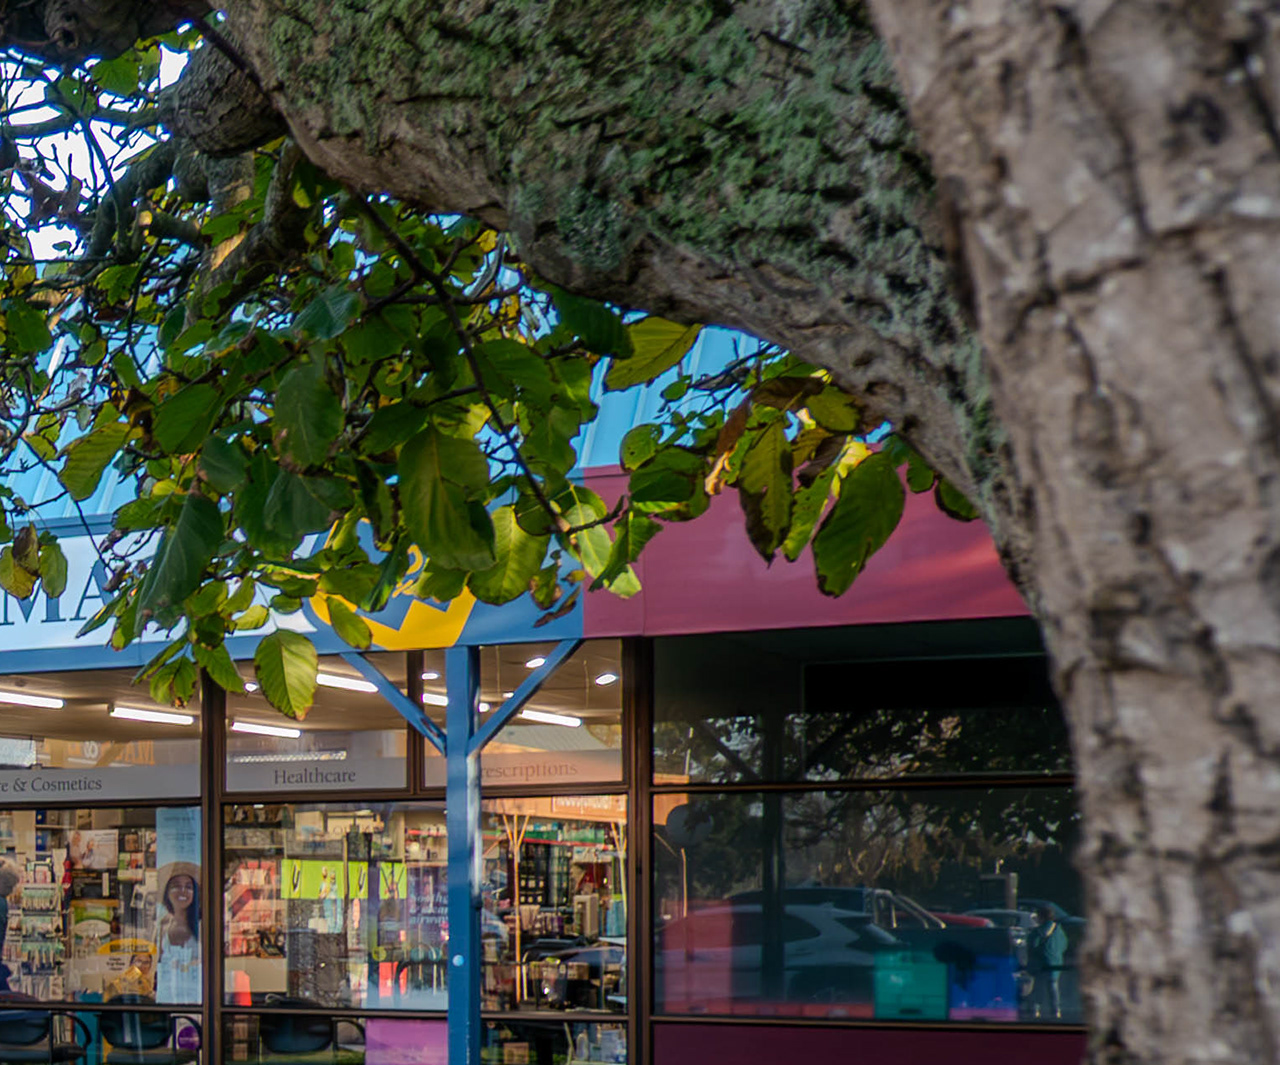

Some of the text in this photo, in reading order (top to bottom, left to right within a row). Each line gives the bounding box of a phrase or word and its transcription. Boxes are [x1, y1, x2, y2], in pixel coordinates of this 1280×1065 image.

[273, 766, 356, 785] Healthcare
[480, 762, 578, 782] rescriptions
[13, 778, 28, 792] &
[31, 776, 102, 792] Cosmetics
